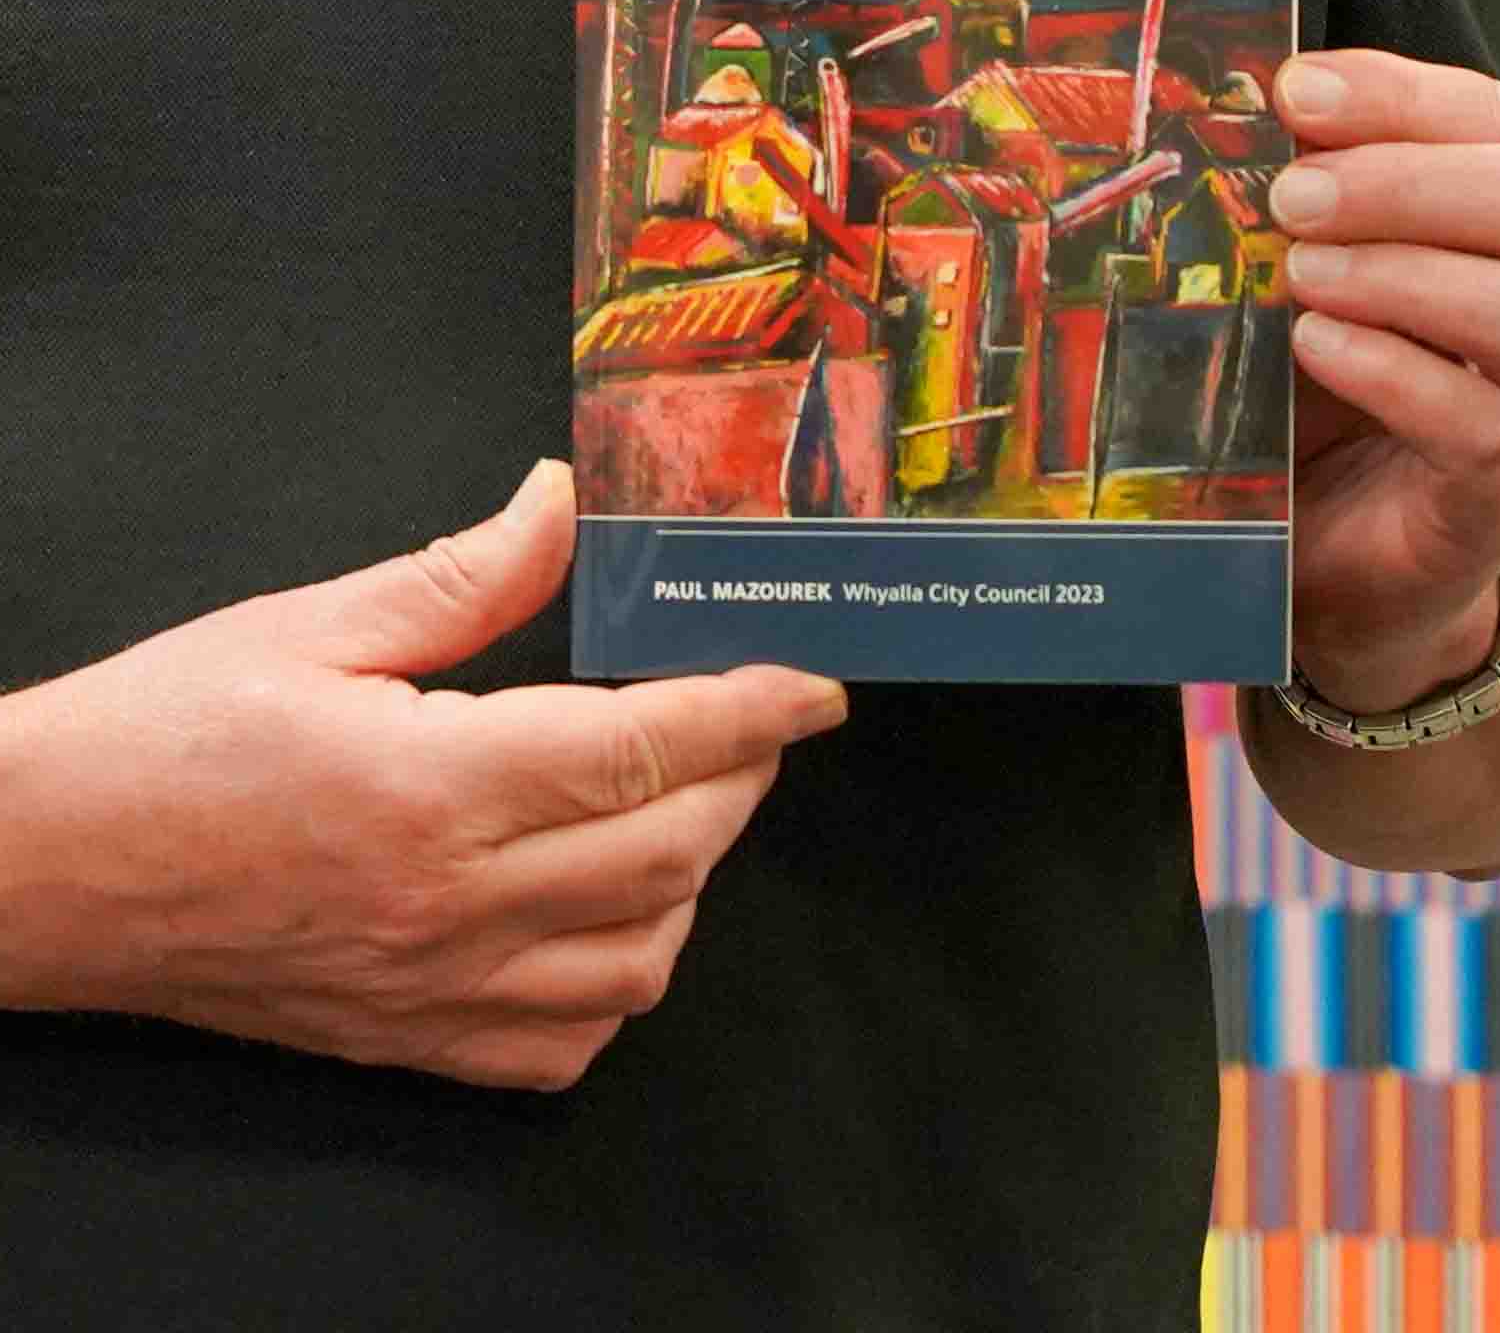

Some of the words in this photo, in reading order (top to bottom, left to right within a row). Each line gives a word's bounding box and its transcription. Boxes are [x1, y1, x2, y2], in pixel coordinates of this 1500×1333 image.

[653, 580, 708, 601] PAUL
[711, 581, 833, 602] MAZOUREK
[842, 582, 924, 606] Whyalla
[928, 582, 970, 608] City
[973, 583, 1051, 604] Council
[1055, 583, 1105, 605] 2023
